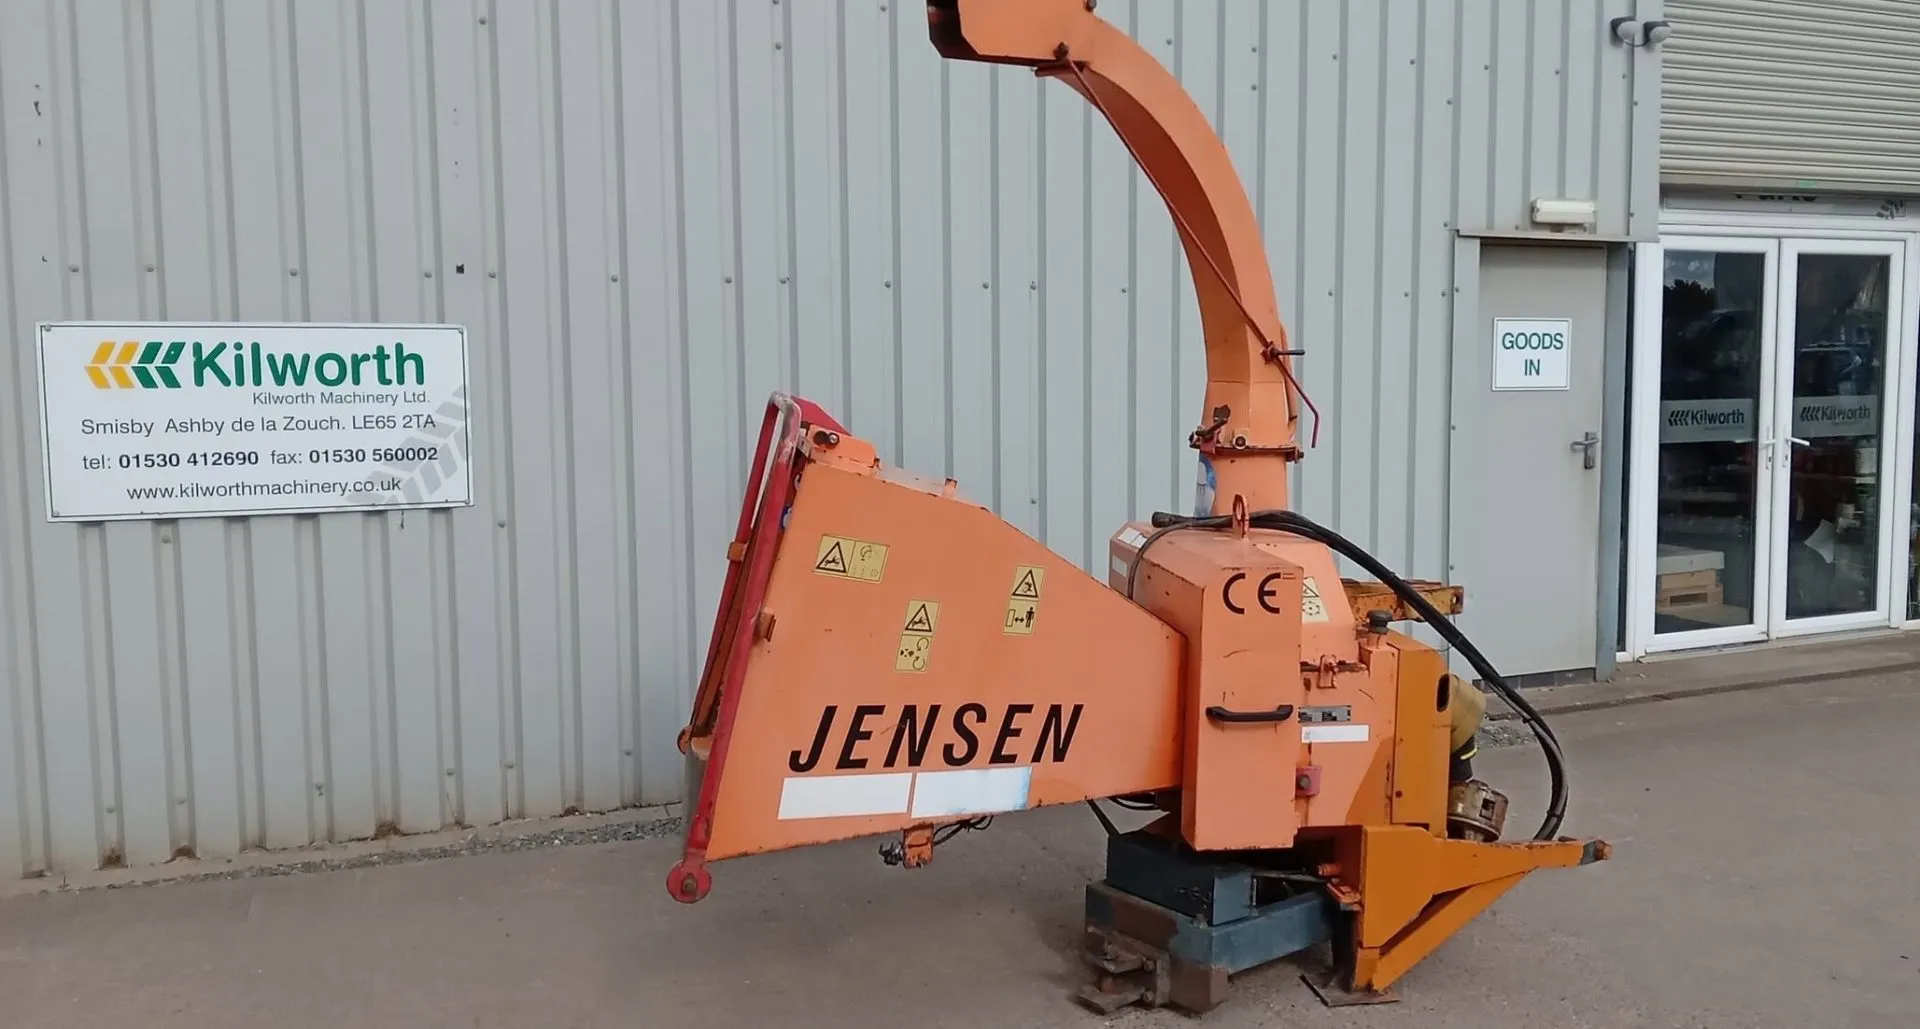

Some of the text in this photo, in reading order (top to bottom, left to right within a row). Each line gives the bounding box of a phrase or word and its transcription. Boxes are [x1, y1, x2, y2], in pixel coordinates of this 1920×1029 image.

[1502, 332, 1564, 350] GOODS
[192, 341, 425, 387] Kilworth
[1524, 359, 1541, 376] IN
[252, 391, 431, 406] Kilworth Machinery Ltd.
[1690, 408, 1745, 425] Kilworth
[1821, 404, 1871, 421] Kilworth
[81, 414, 436, 437] Smisby Ashby de la Zouch. LE65 2TA
[82, 447, 439, 470] tel: 01530 412690 fax: 01530 560002
[127, 477, 402, 499] www.kilworthmachinery.co.uk
[1222, 572, 1282, 615] CE
[788, 702, 1085, 773] JENSEN
